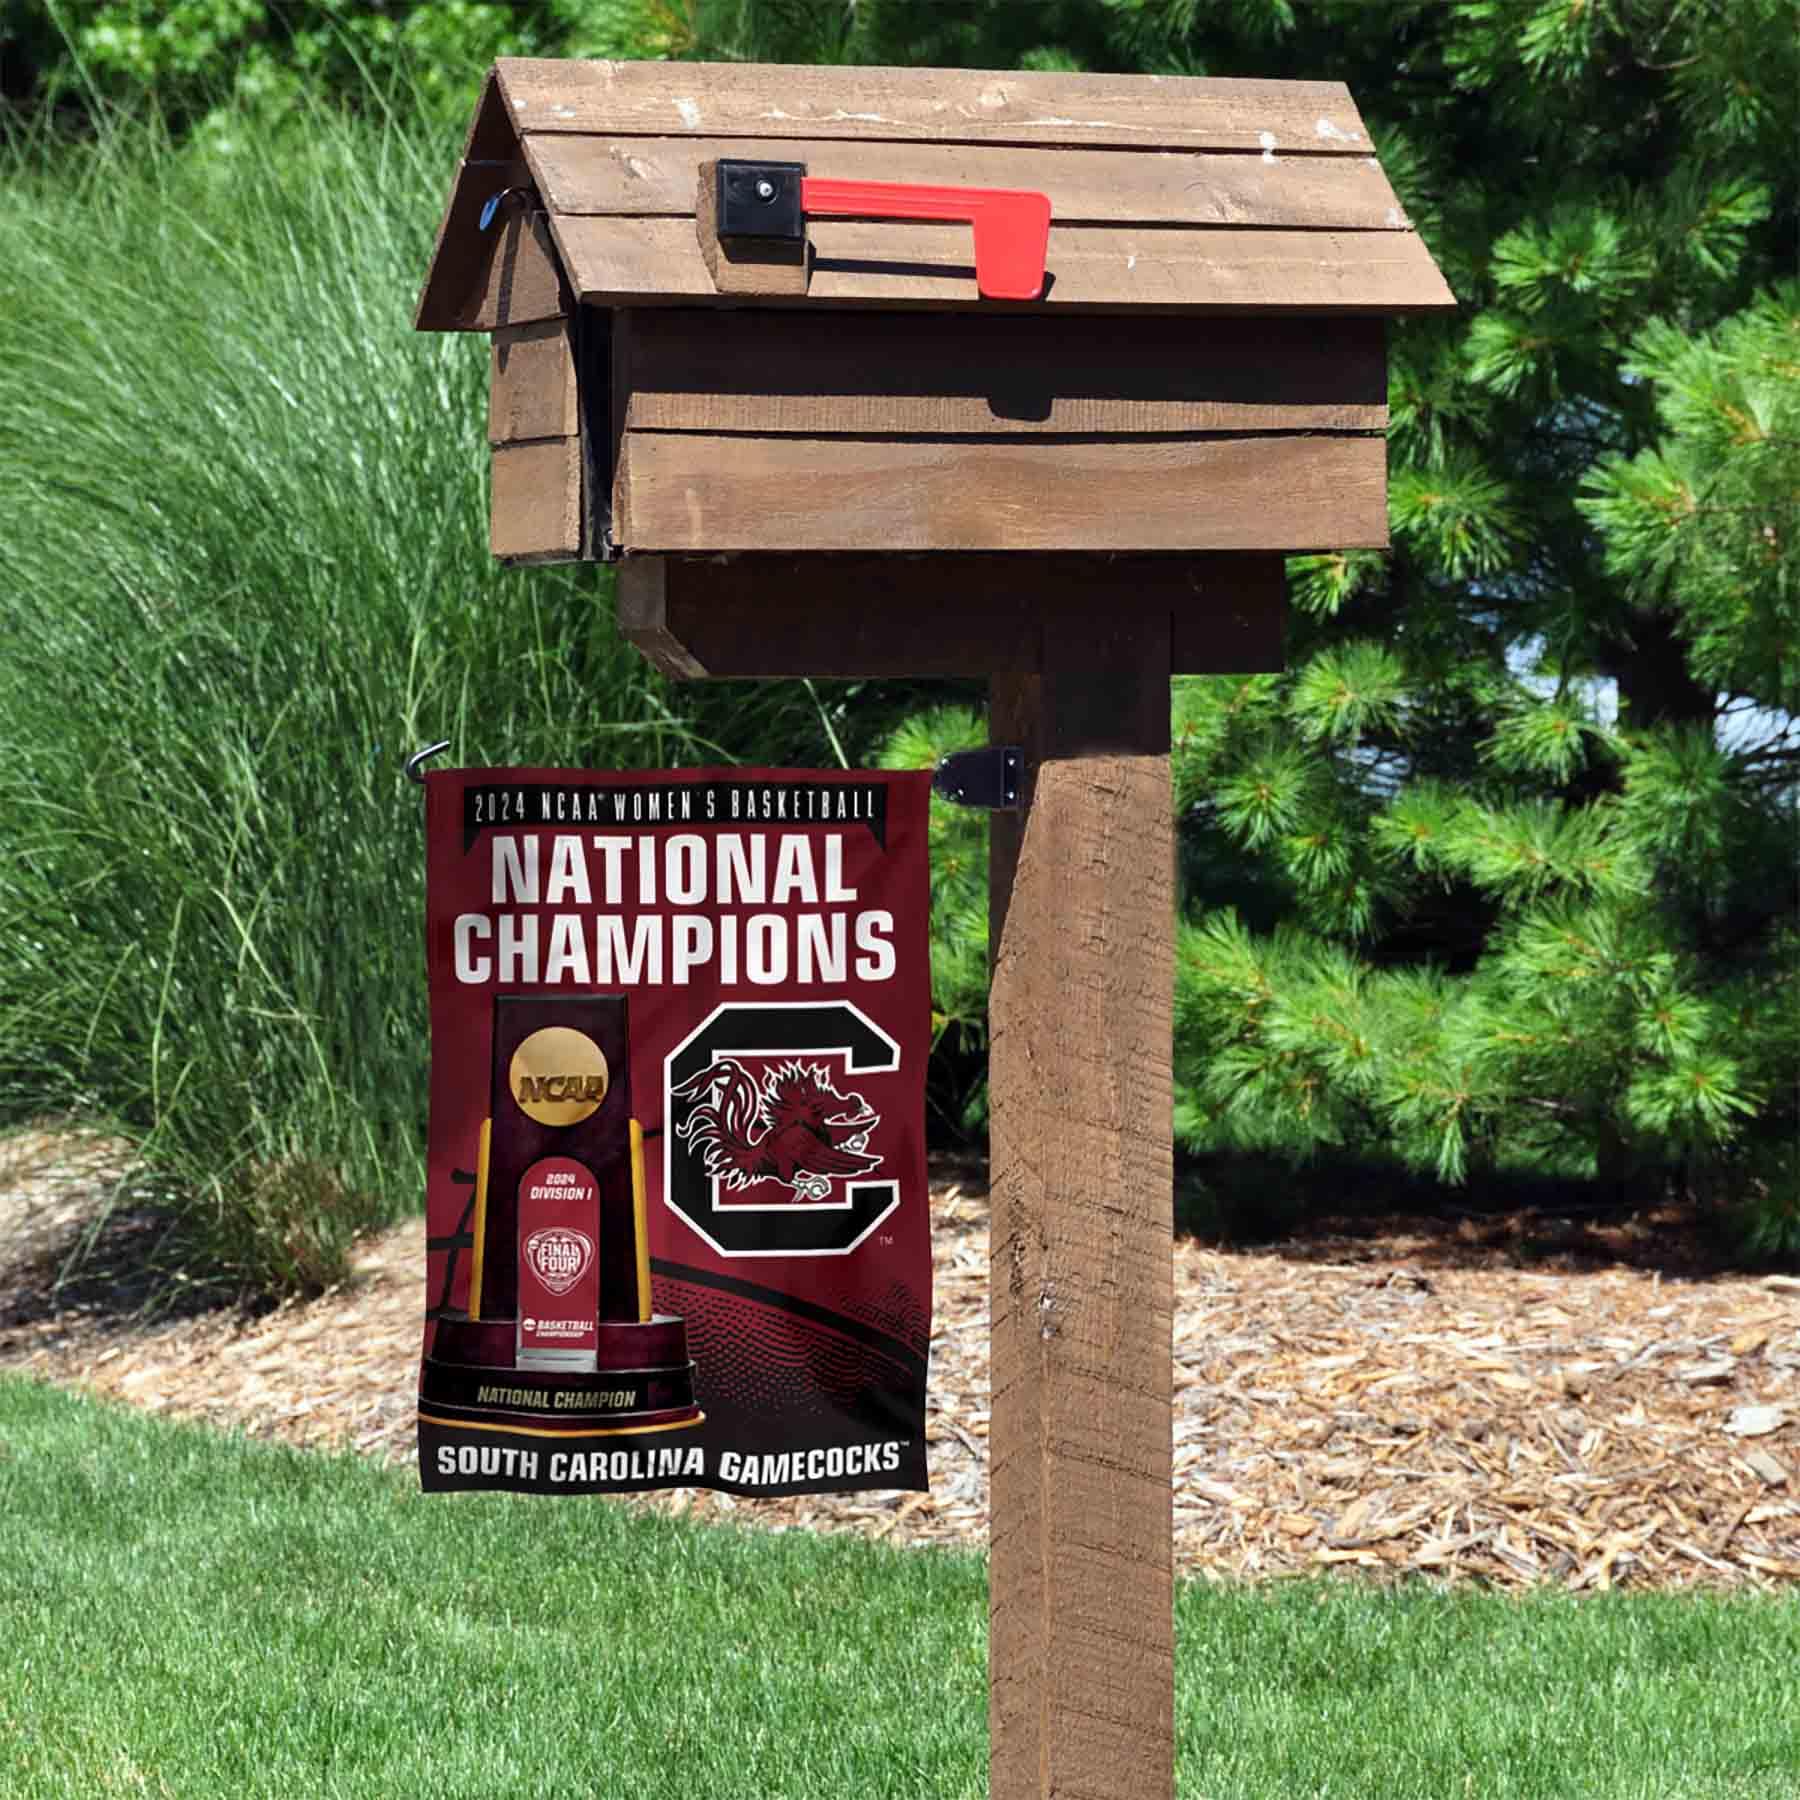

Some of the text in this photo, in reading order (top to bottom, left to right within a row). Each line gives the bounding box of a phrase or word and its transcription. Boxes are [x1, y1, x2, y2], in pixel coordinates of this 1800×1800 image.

[475, 789, 875, 823] 2024 NCAA WOMEN'S BASKETBALL
[491, 833, 858, 906] NATIONAL
[453, 909, 897, 985] CHAMPIONS
[519, 1073, 605, 1105] NCAA
[545, 1173, 576, 1185] 2024
[529, 1186, 593, 1200] DIVISION I
[540, 1242, 578, 1257] FINAL
[540, 1256, 578, 1273] FOUR
[537, 1319, 594, 1331] BASKETBALL
[477, 1385, 637, 1409] NATIONAL CHAMPION
[437, 1445, 539, 1480] SOUTH
[549, 1447, 706, 1482] CAROLINA
